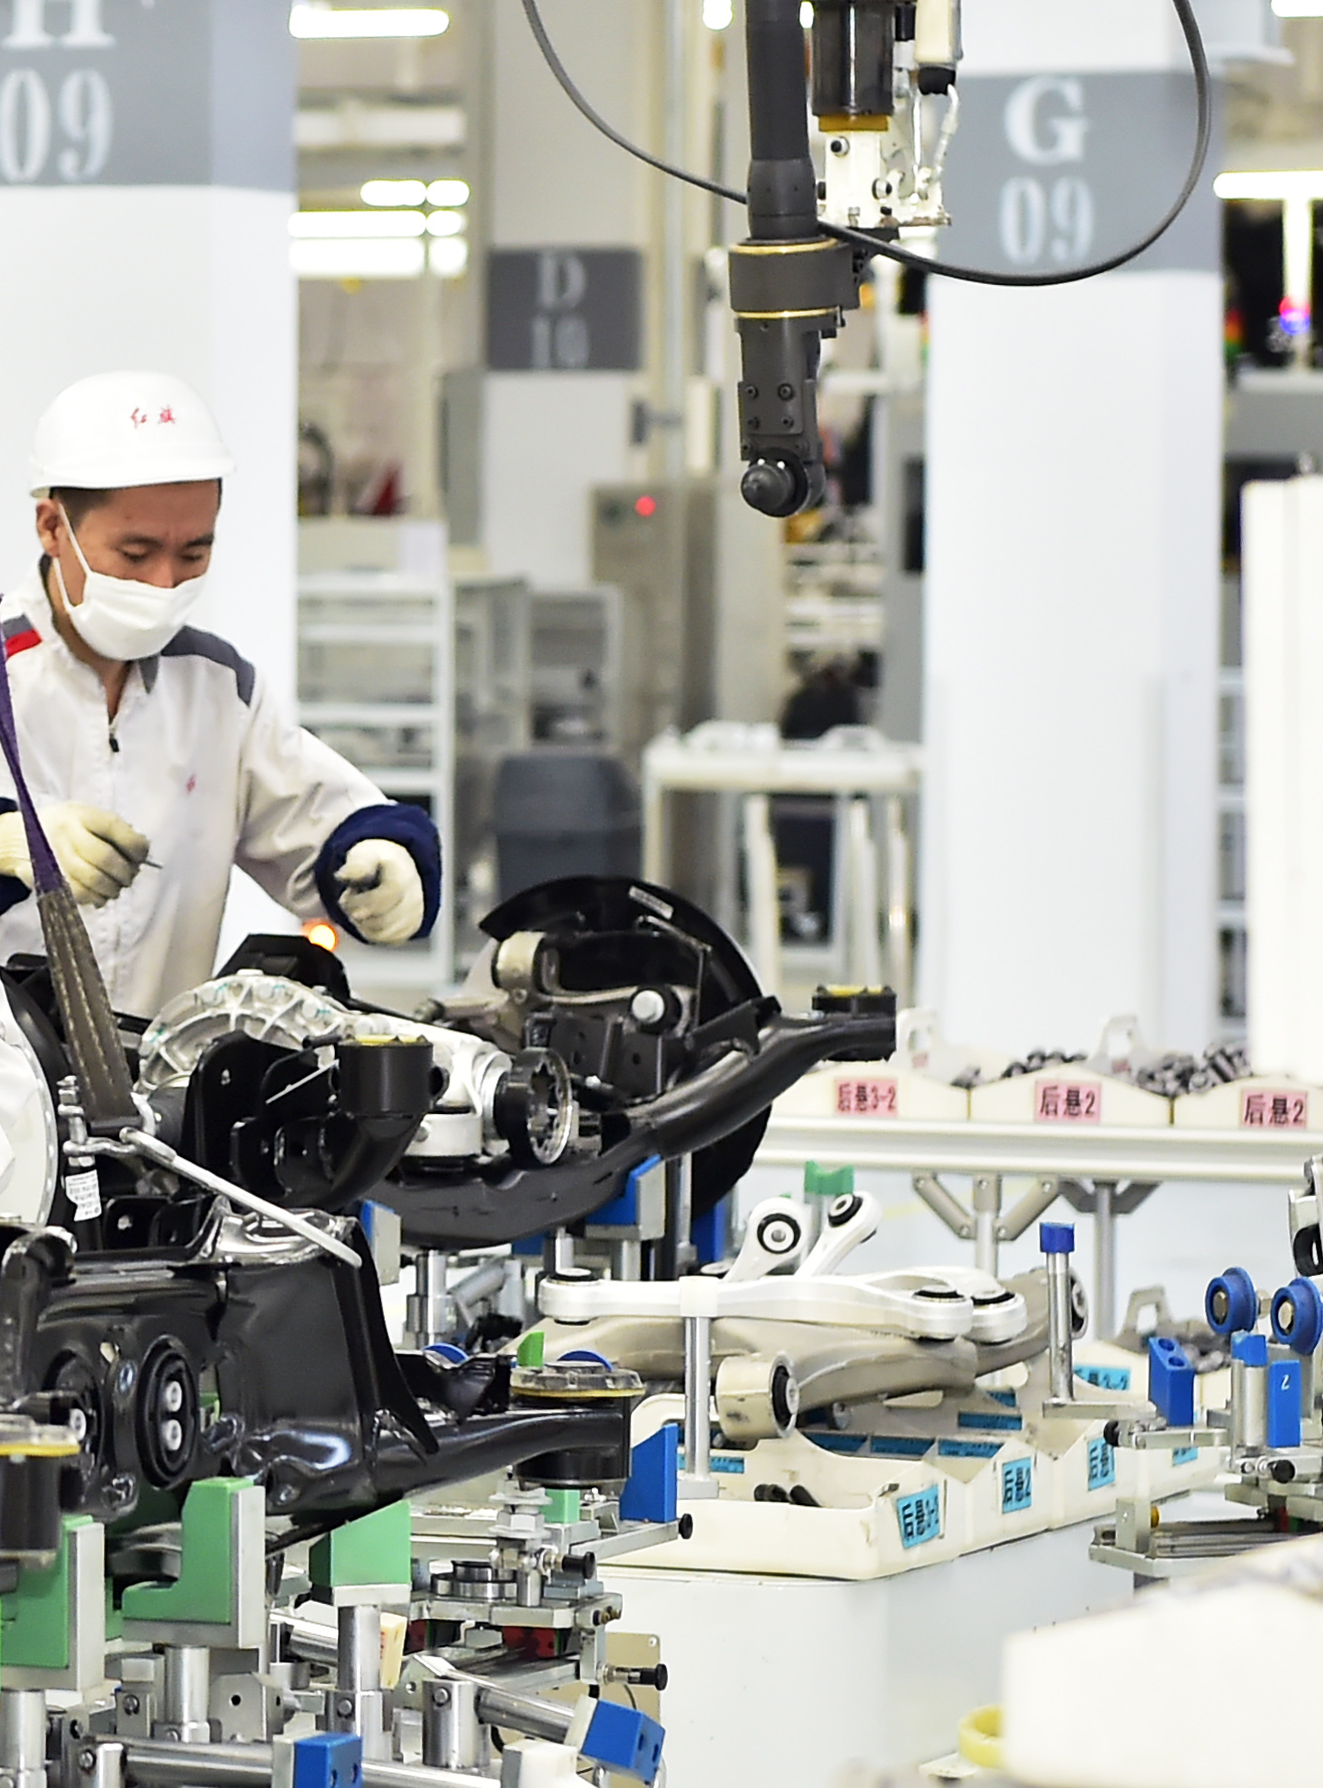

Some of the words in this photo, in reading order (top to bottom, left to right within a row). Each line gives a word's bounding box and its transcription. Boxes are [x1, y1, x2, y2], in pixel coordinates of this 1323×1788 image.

[1003, 75, 1090, 165] G
[999, 175, 1095, 267] 09
[537, 254, 587, 309] D
[1040, 1085, 1096, 1118] 后悬2
[1244, 1094, 1305, 1126] 后悬2
